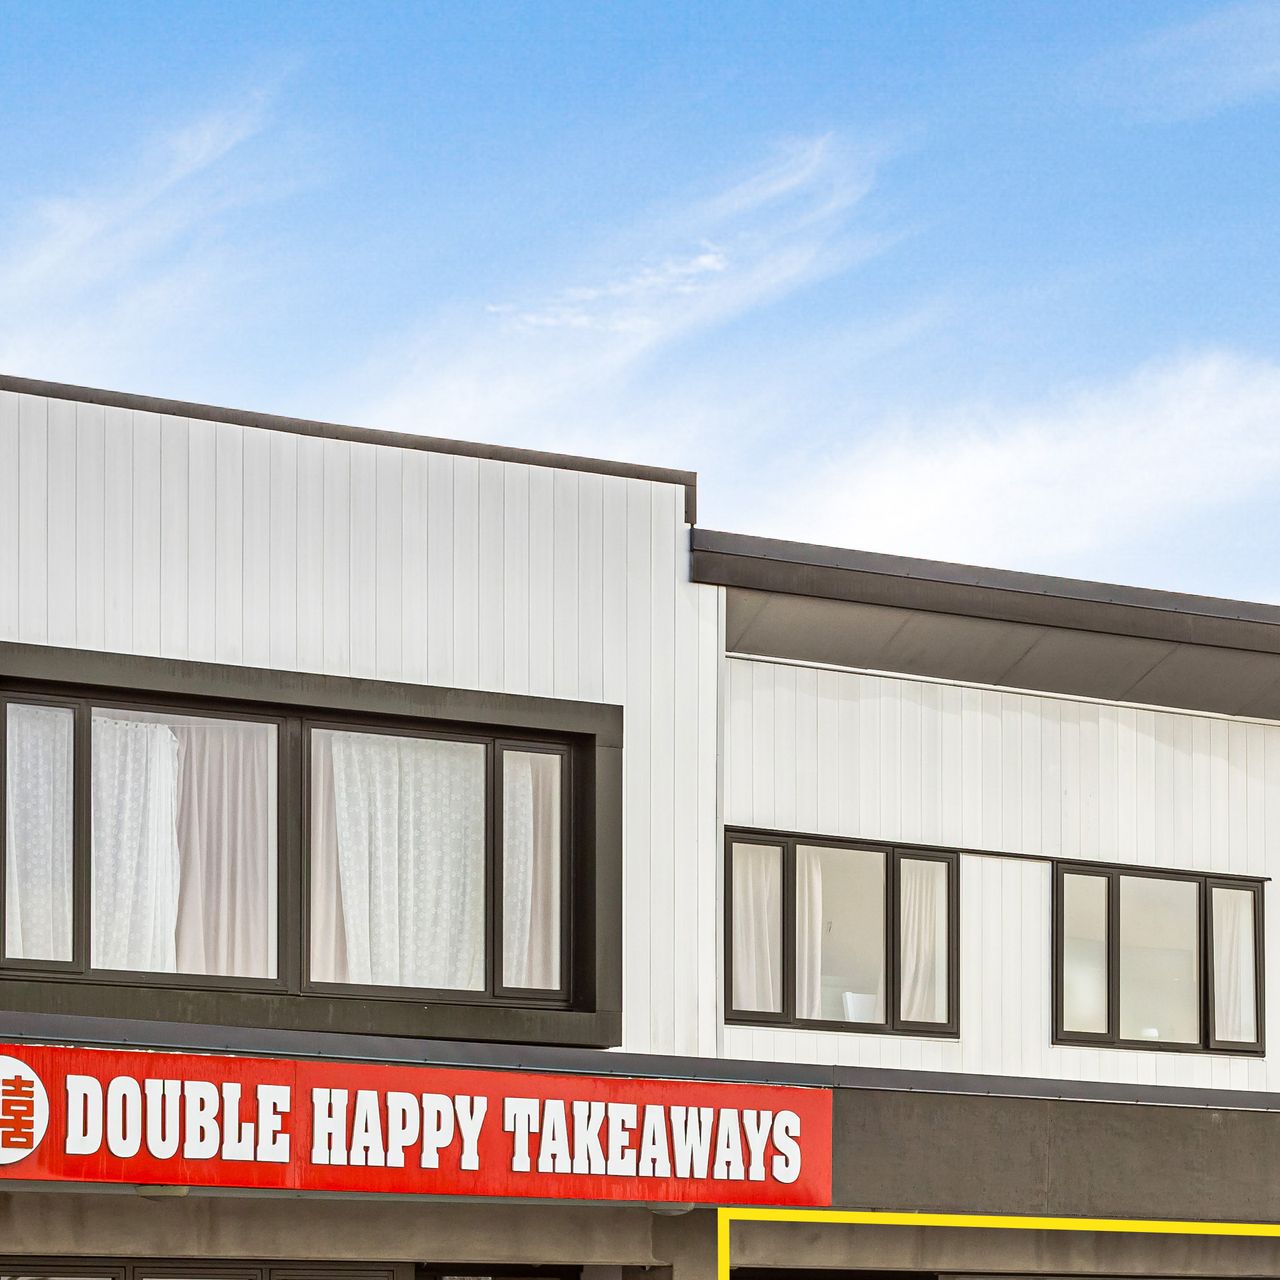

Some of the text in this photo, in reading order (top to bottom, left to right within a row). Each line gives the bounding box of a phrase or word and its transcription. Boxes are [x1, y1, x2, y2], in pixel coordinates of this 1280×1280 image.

[65, 1074, 802, 1185] DOUBLE HAPPY TAKEAWAYS
